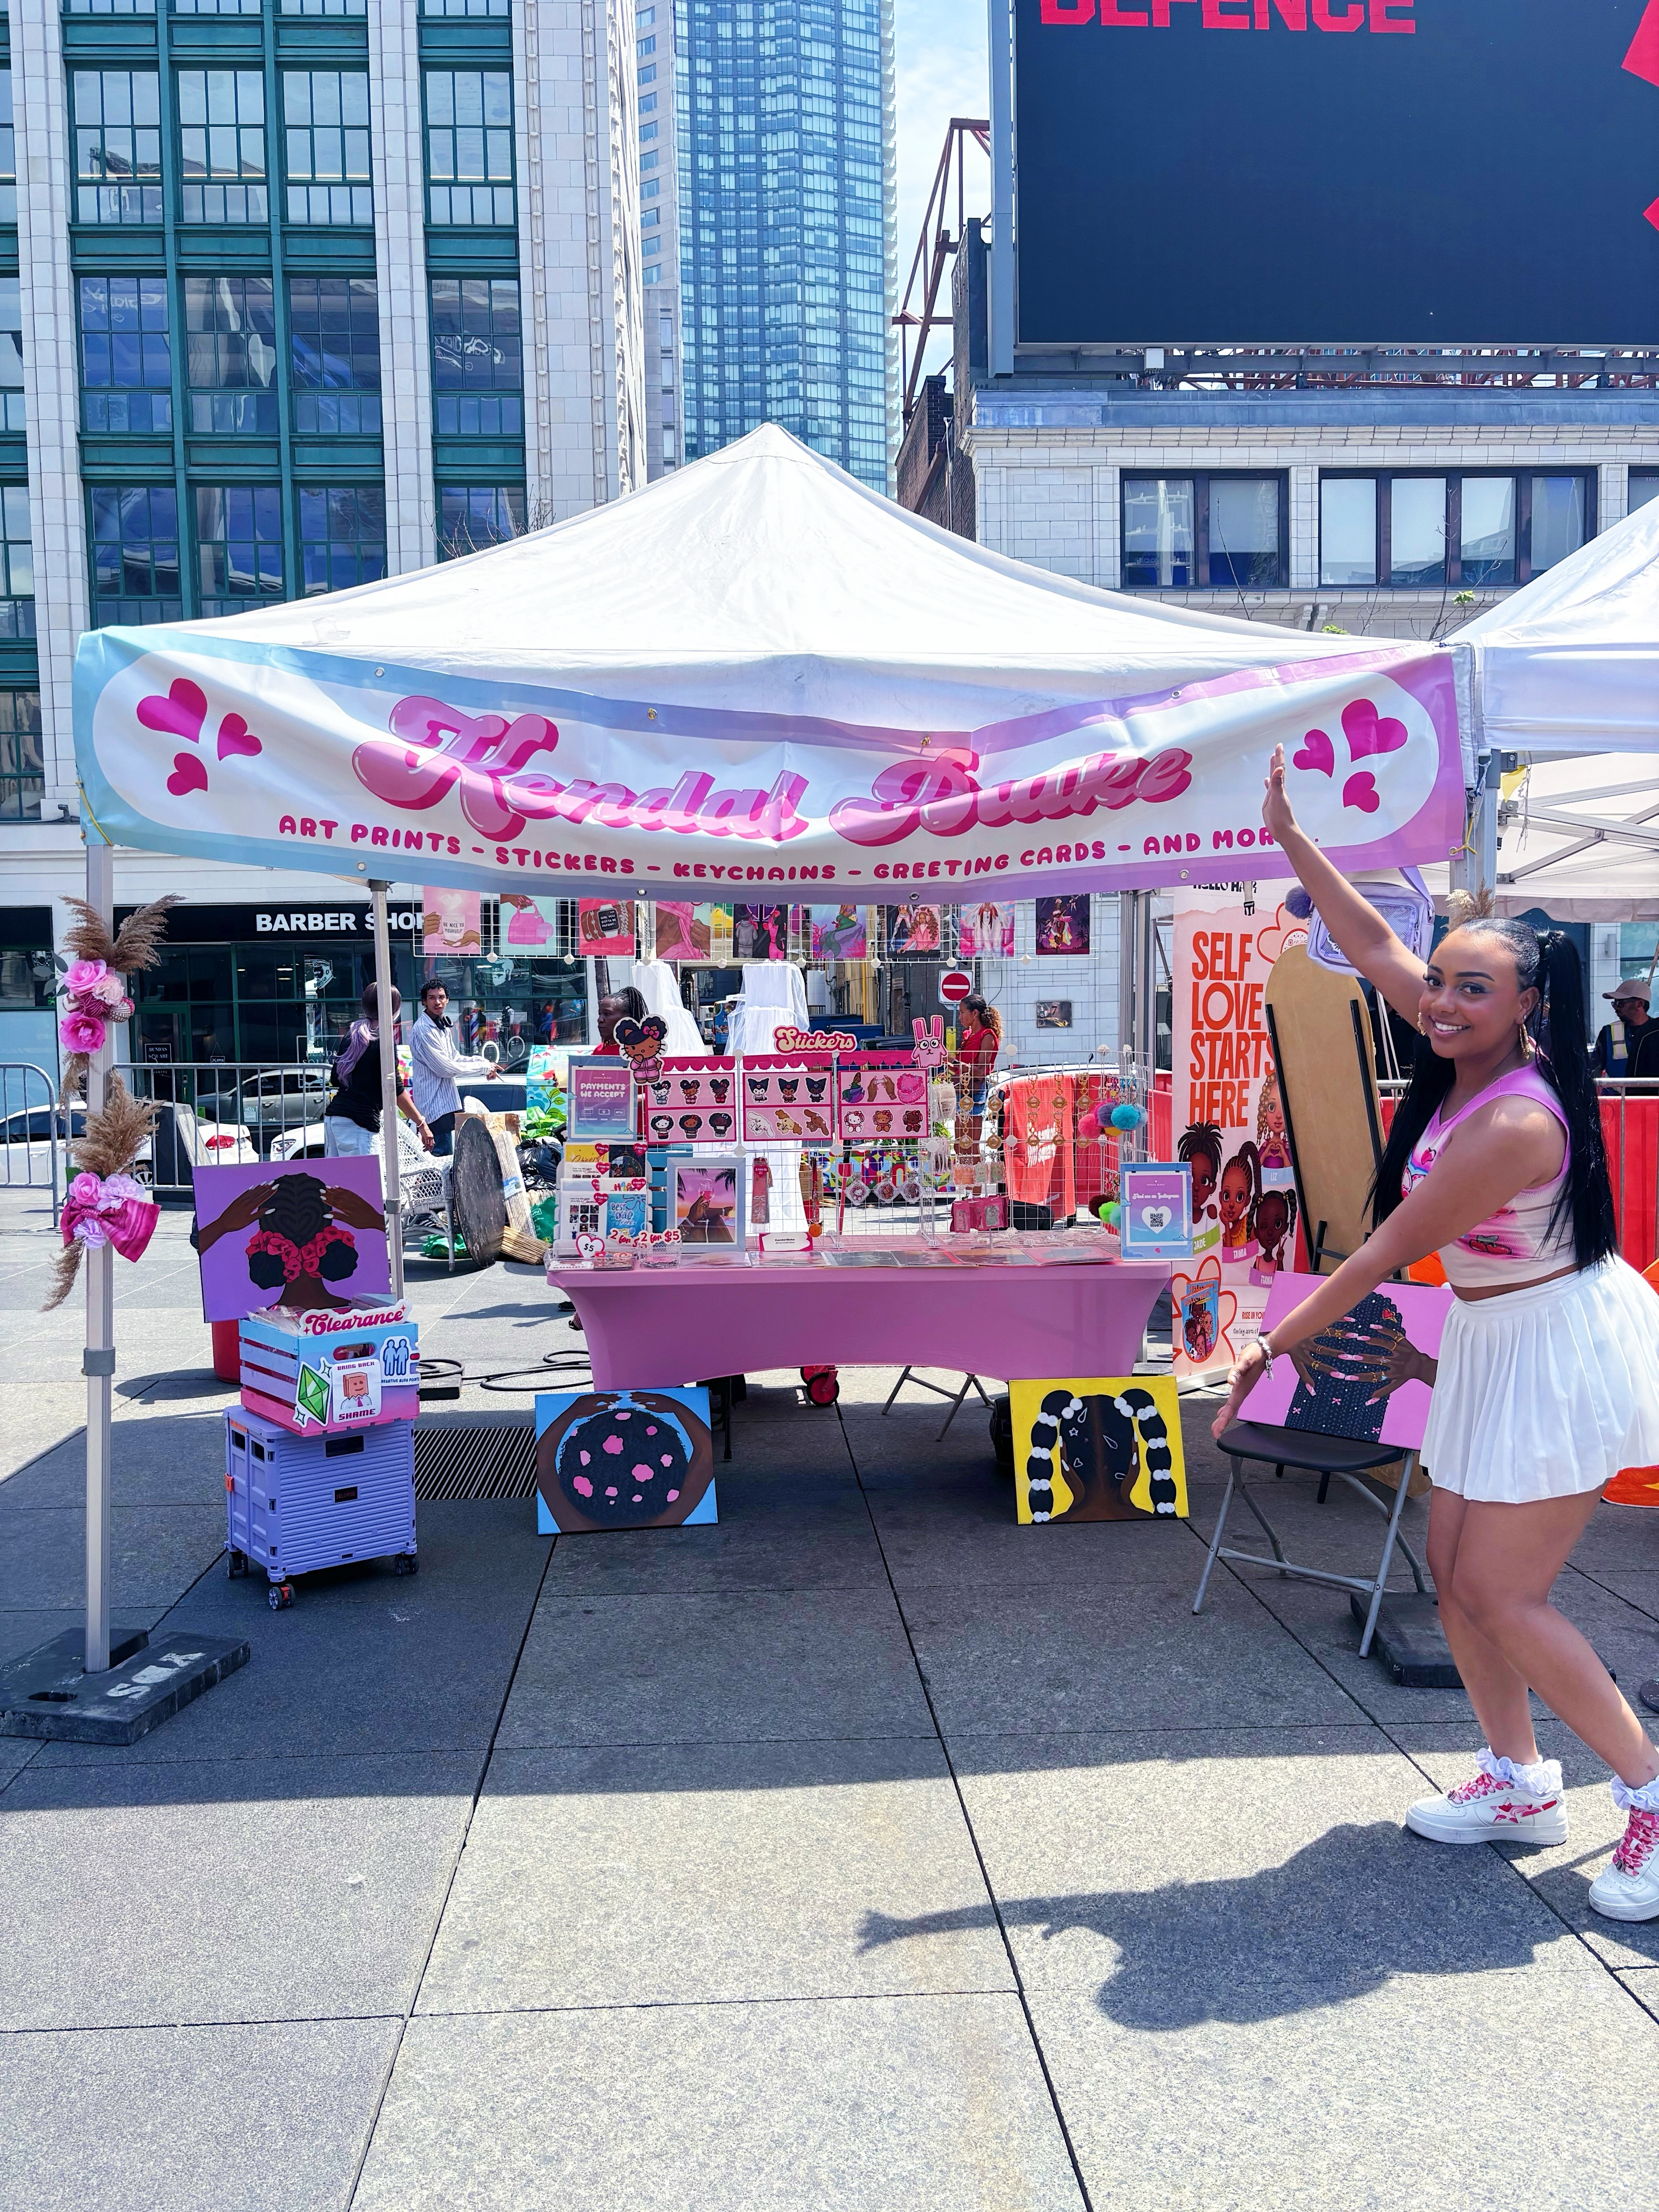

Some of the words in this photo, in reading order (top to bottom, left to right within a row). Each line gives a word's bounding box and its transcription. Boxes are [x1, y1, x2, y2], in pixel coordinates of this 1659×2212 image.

[352, 696, 809, 842] Kendal
[279, 815, 339, 840] ART
[351, 824, 461, 855] PRINTS
[496, 848, 635, 874] STICKERS
[673, 864, 835, 881] KEYCHAINS
[874, 854, 1009, 879] GREETING
[1021, 840, 1105, 867] CARDS
[1144, 833, 1201, 855] AND
[1213, 827, 1274, 849] MOR
[1231, 881, 1257, 893] HAR
[256, 913, 357, 932] BARBER
[1192, 931, 1253, 981] SELF
[1051, 1006, 1058, 1015] 7
[1191, 982, 1264, 1030] LOVE
[775, 1028, 854, 1052] Stickers
[148, 1054, 169, 1063] SQUARE
[1190, 1031, 1276, 1081] STARTS
[1190, 1081, 1250, 1128] HERE
[610, 1230, 618, 1239] 2
[640, 1232, 647, 1242] 2
[664, 1231, 680, 1243] $5
[584, 1243, 595, 1252] $5
[1193, 1238, 1206, 1251] JADE
[1233, 1247, 1247, 1259] TAMIA
[1260, 1275, 1273, 1285] TIANA
[1242, 1311, 1250, 1319] RISE
[1251, 1311, 1256, 1319] IN
[305, 1310, 404, 1336] Clearance
[339, 1408, 376, 1421] SHAME
